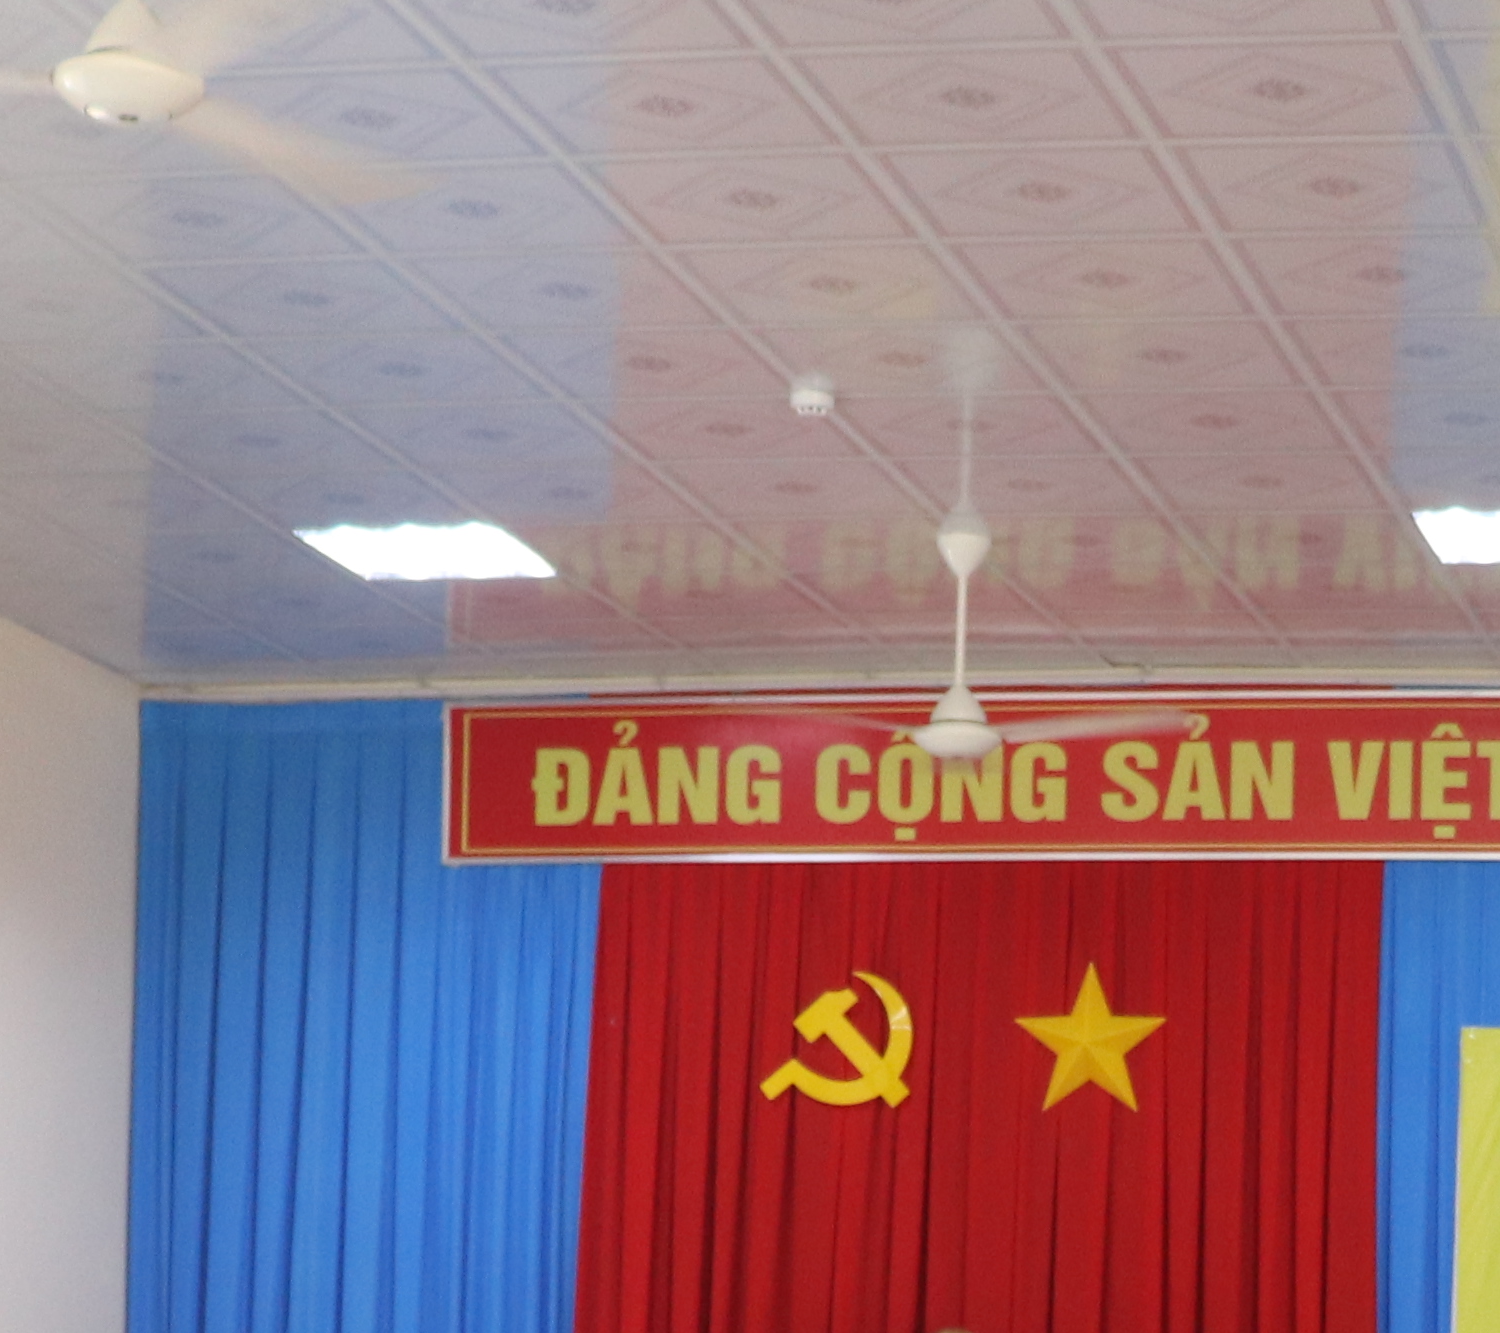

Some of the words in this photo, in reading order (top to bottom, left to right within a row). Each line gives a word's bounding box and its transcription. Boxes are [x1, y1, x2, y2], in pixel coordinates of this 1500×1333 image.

[532, 720, 782, 825] ĐẢNG
[815, 726, 1072, 841] CỘNG
[1095, 709, 1295, 821] SẢN
